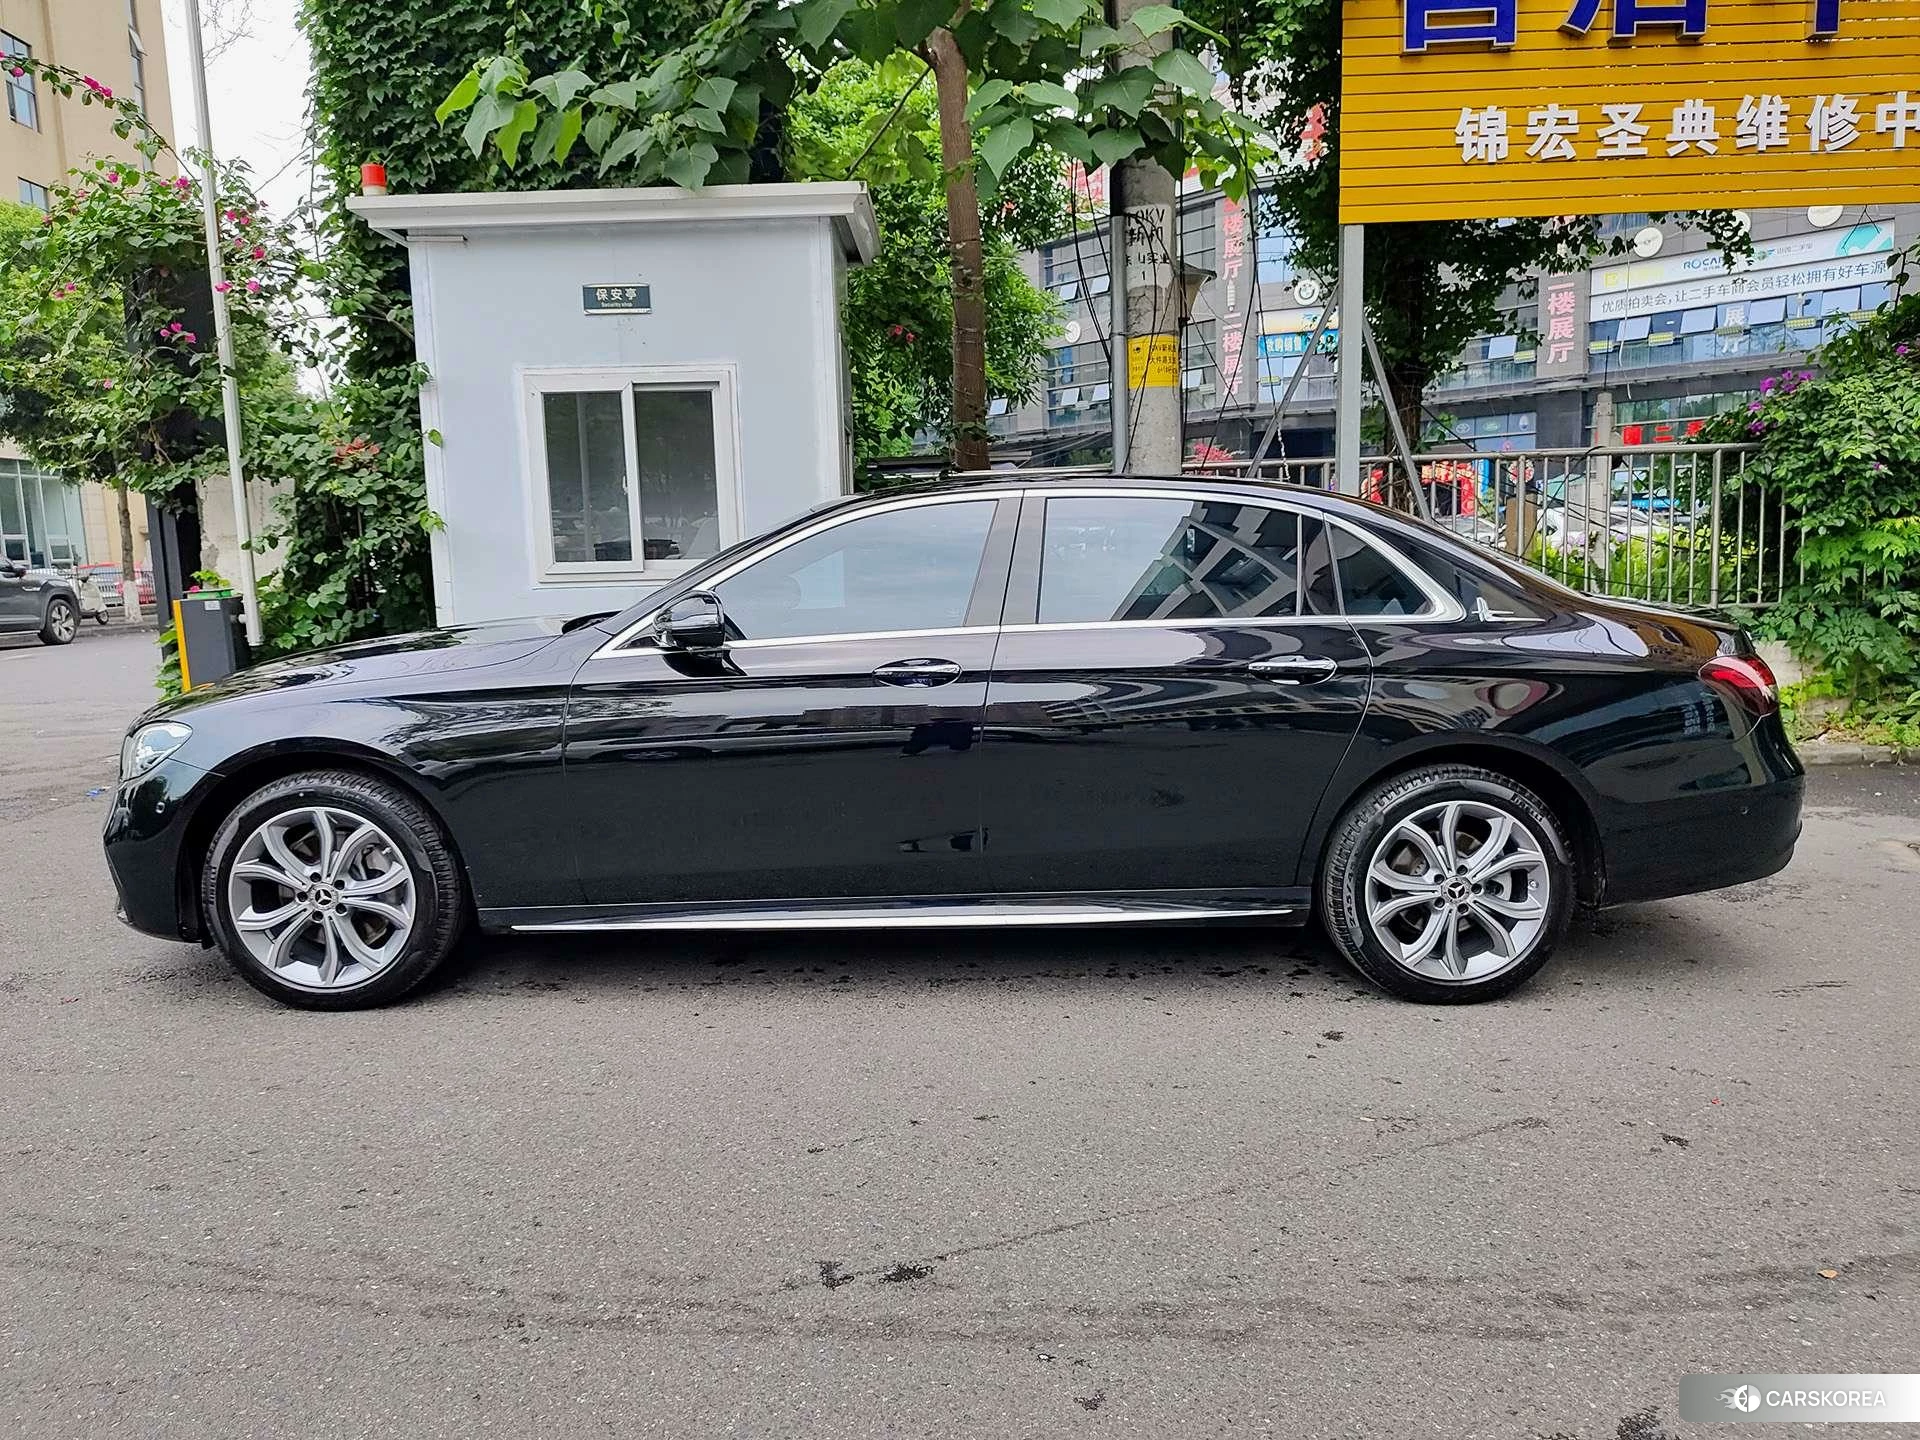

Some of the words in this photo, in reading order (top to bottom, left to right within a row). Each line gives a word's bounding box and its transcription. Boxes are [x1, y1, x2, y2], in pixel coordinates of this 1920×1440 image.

[1454, 91, 1920, 164] 锦宏圣典维修中
[596, 287, 637, 301] 保安亭
